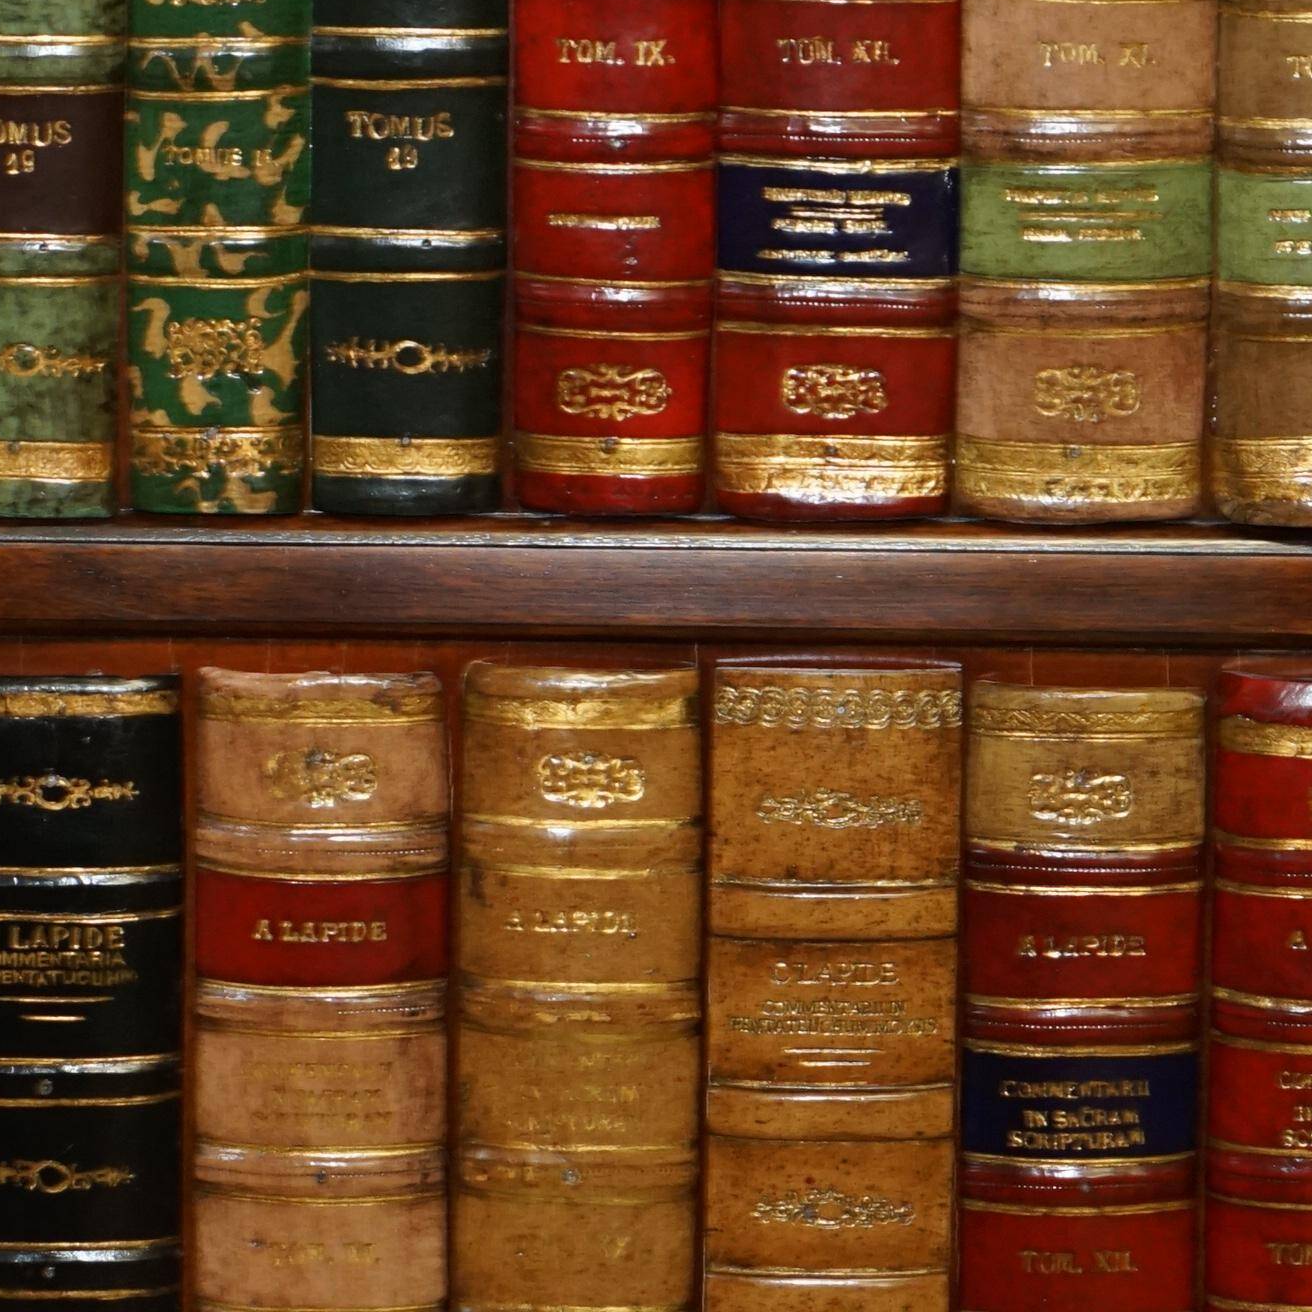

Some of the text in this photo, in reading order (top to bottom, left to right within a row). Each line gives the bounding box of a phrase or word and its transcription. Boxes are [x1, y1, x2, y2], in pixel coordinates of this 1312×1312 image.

[557, 38, 624, 66] TOM.
[343, 109, 456, 141] TOMUS
[6, 924, 126, 950] LAPIDE
[251, 919, 388, 943] A LAPIDE
[1289, 930, 1309, 952] A
[1016, 934, 1147, 958] A LAPIDE
[1022, 1108, 1048, 1129] IN
